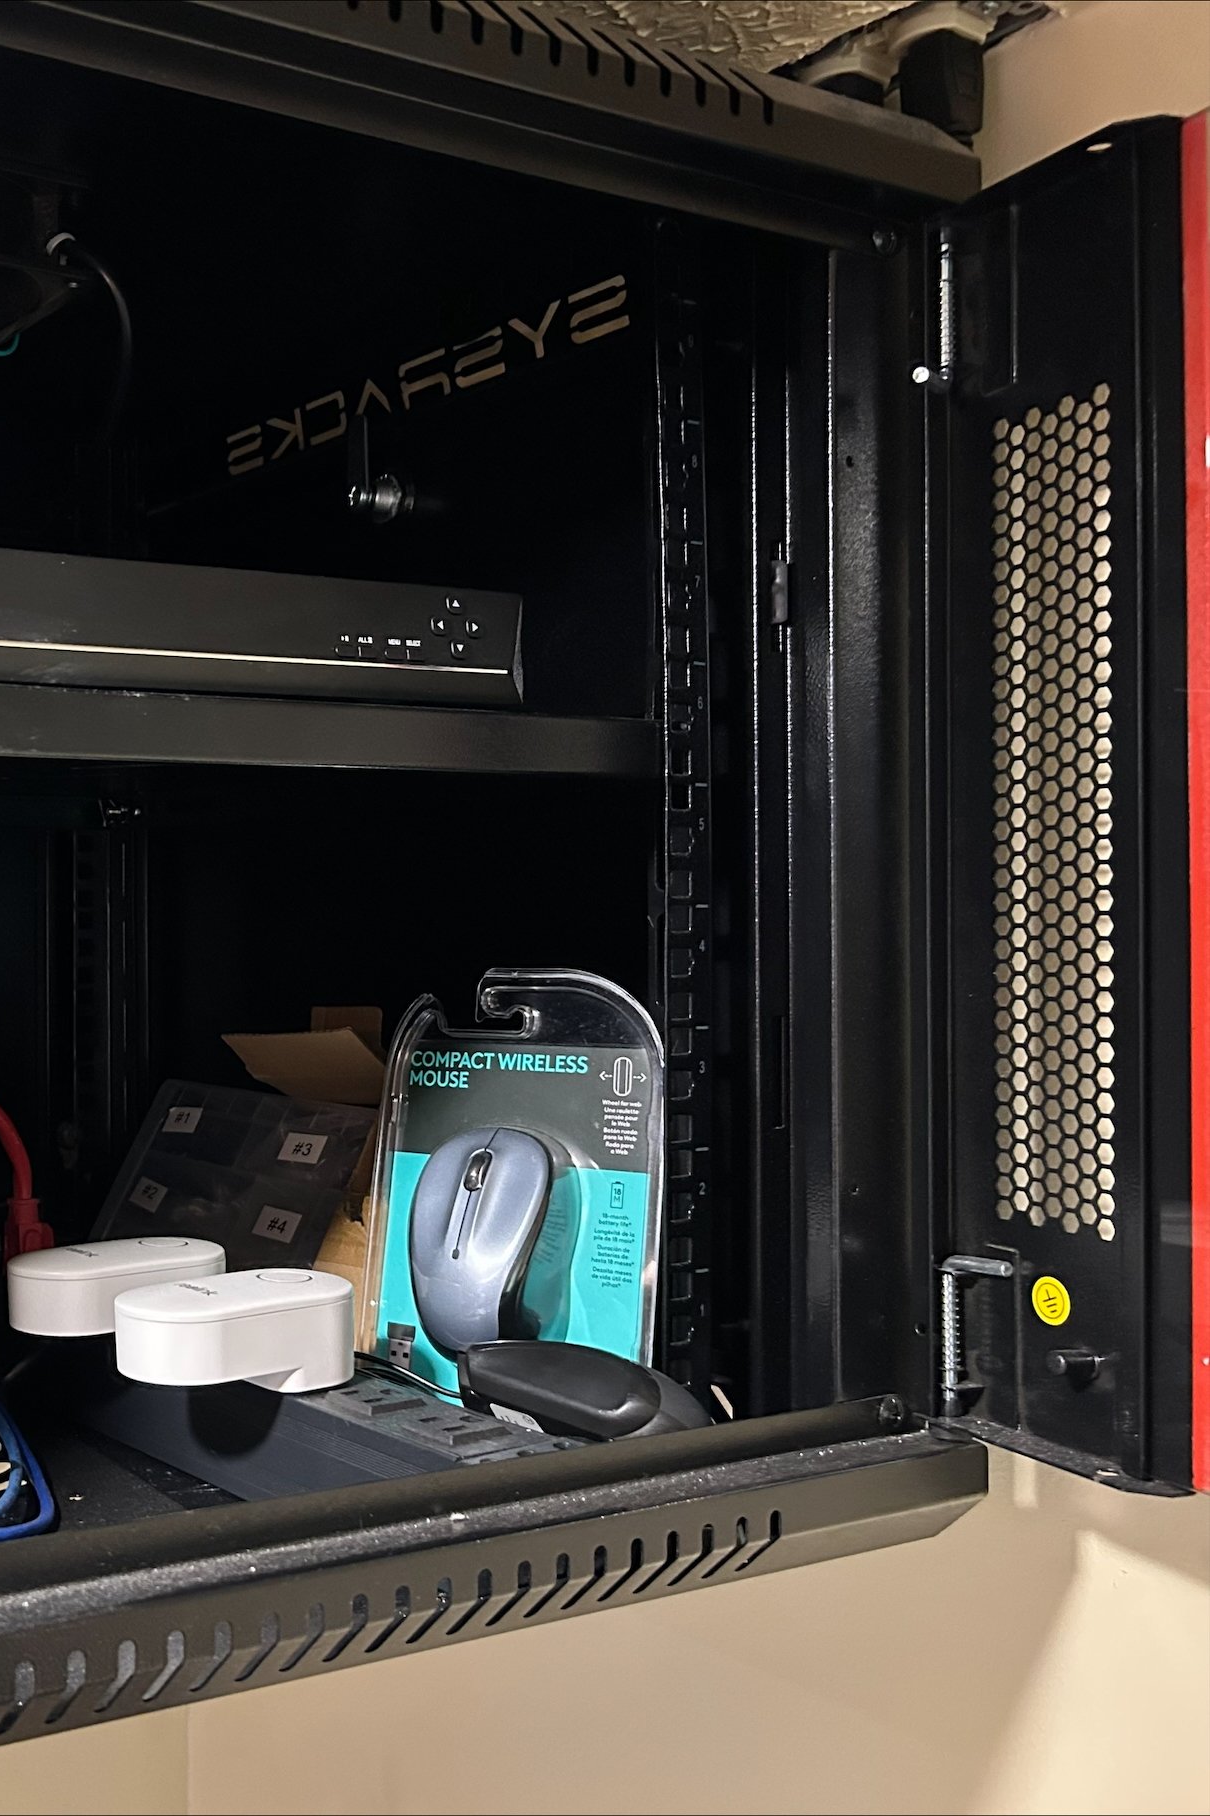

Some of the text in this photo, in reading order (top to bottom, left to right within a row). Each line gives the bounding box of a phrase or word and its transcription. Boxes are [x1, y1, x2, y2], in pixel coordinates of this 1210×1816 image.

[698, 818, 705, 831] 5
[699, 940, 706, 953] 4
[410, 1050, 589, 1075] COMPACT WIRELESS
[699, 1061, 706, 1074] 3
[409, 1070, 469, 1089] MOUSE
[174, 1112, 191, 1124] #1
[292, 1141, 312, 1156] #3
[141, 1184, 159, 1200] #2
[613, 1188, 622, 1196] 18
[699, 1183, 706, 1195] 2
[266, 1216, 287, 1234] #4
